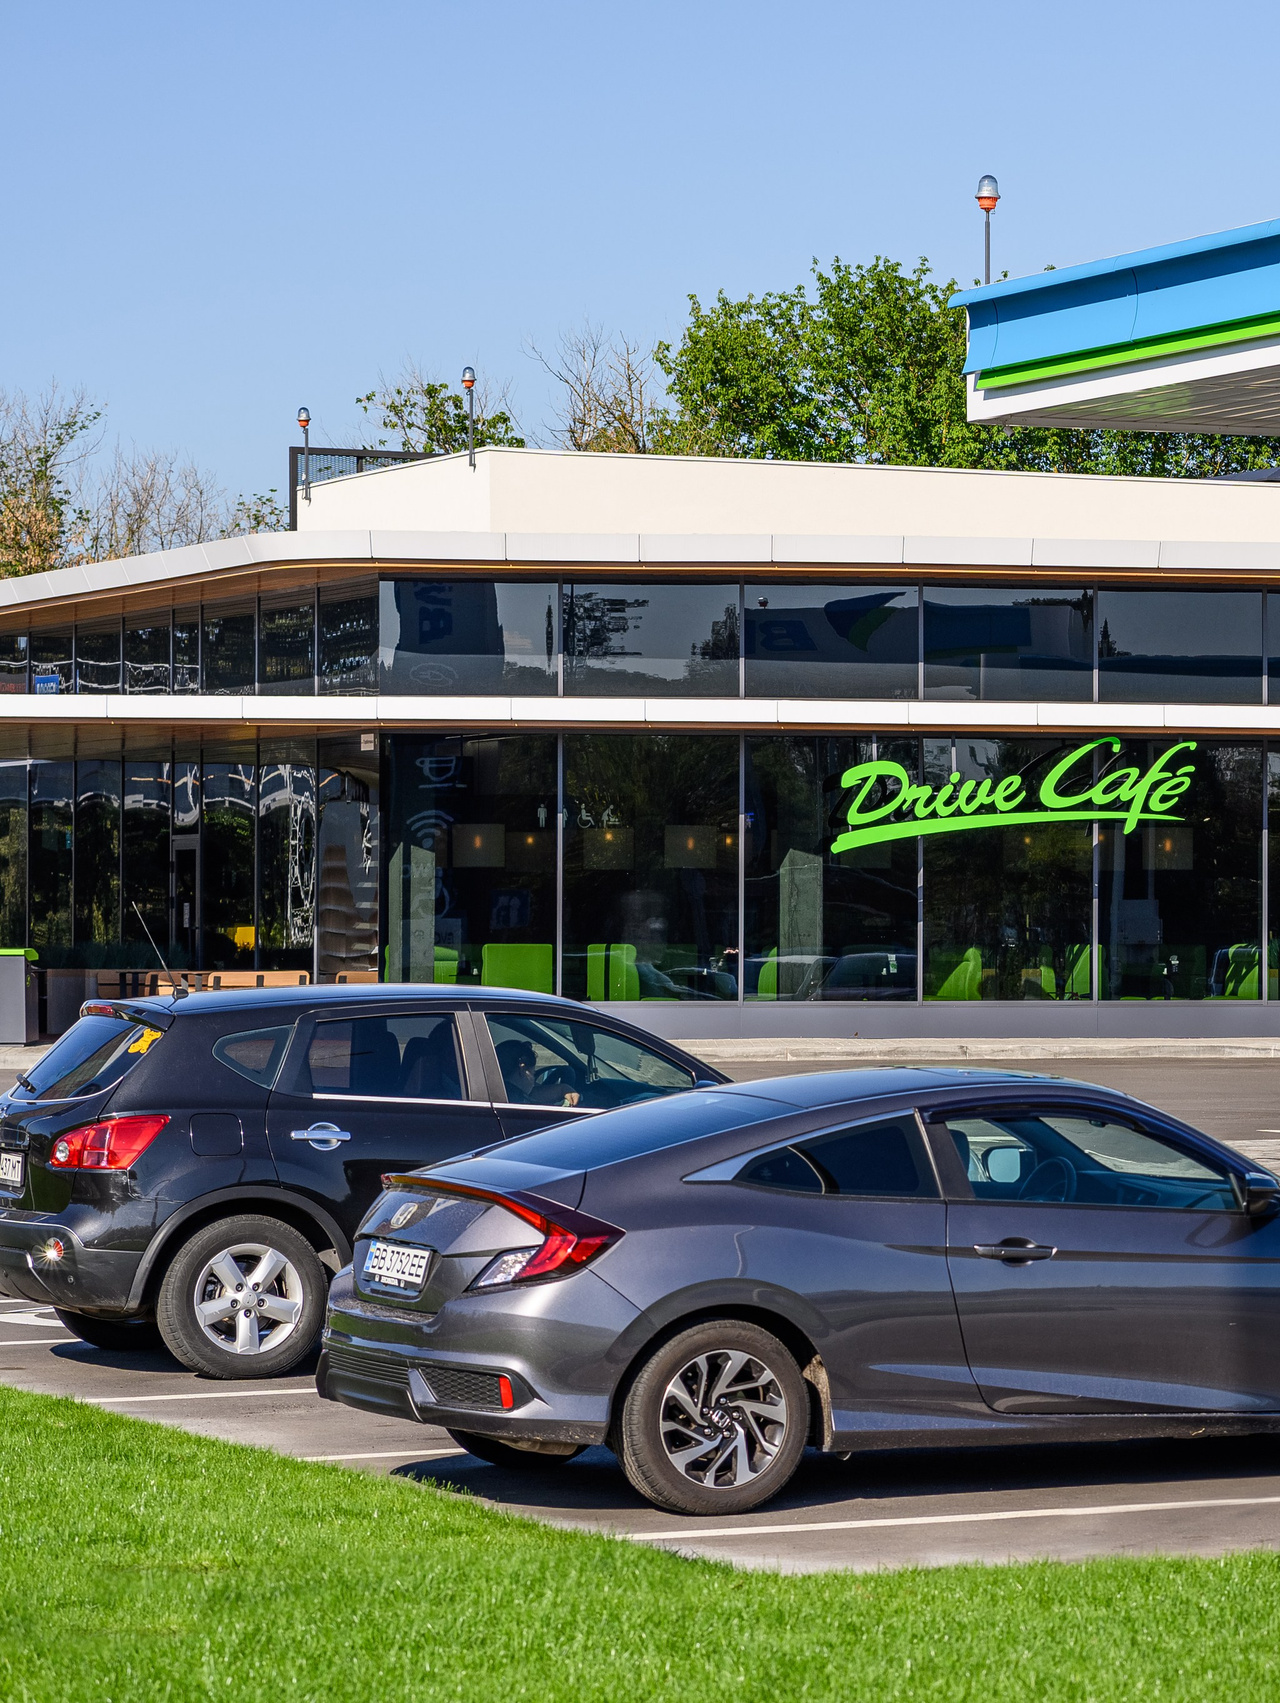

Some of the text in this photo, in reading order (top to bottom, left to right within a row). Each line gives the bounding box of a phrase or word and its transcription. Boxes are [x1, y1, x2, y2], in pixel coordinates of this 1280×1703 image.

[841, 736, 1198, 835] Drive Café
[371, 1247, 426, 1278] BB 3752 EE
